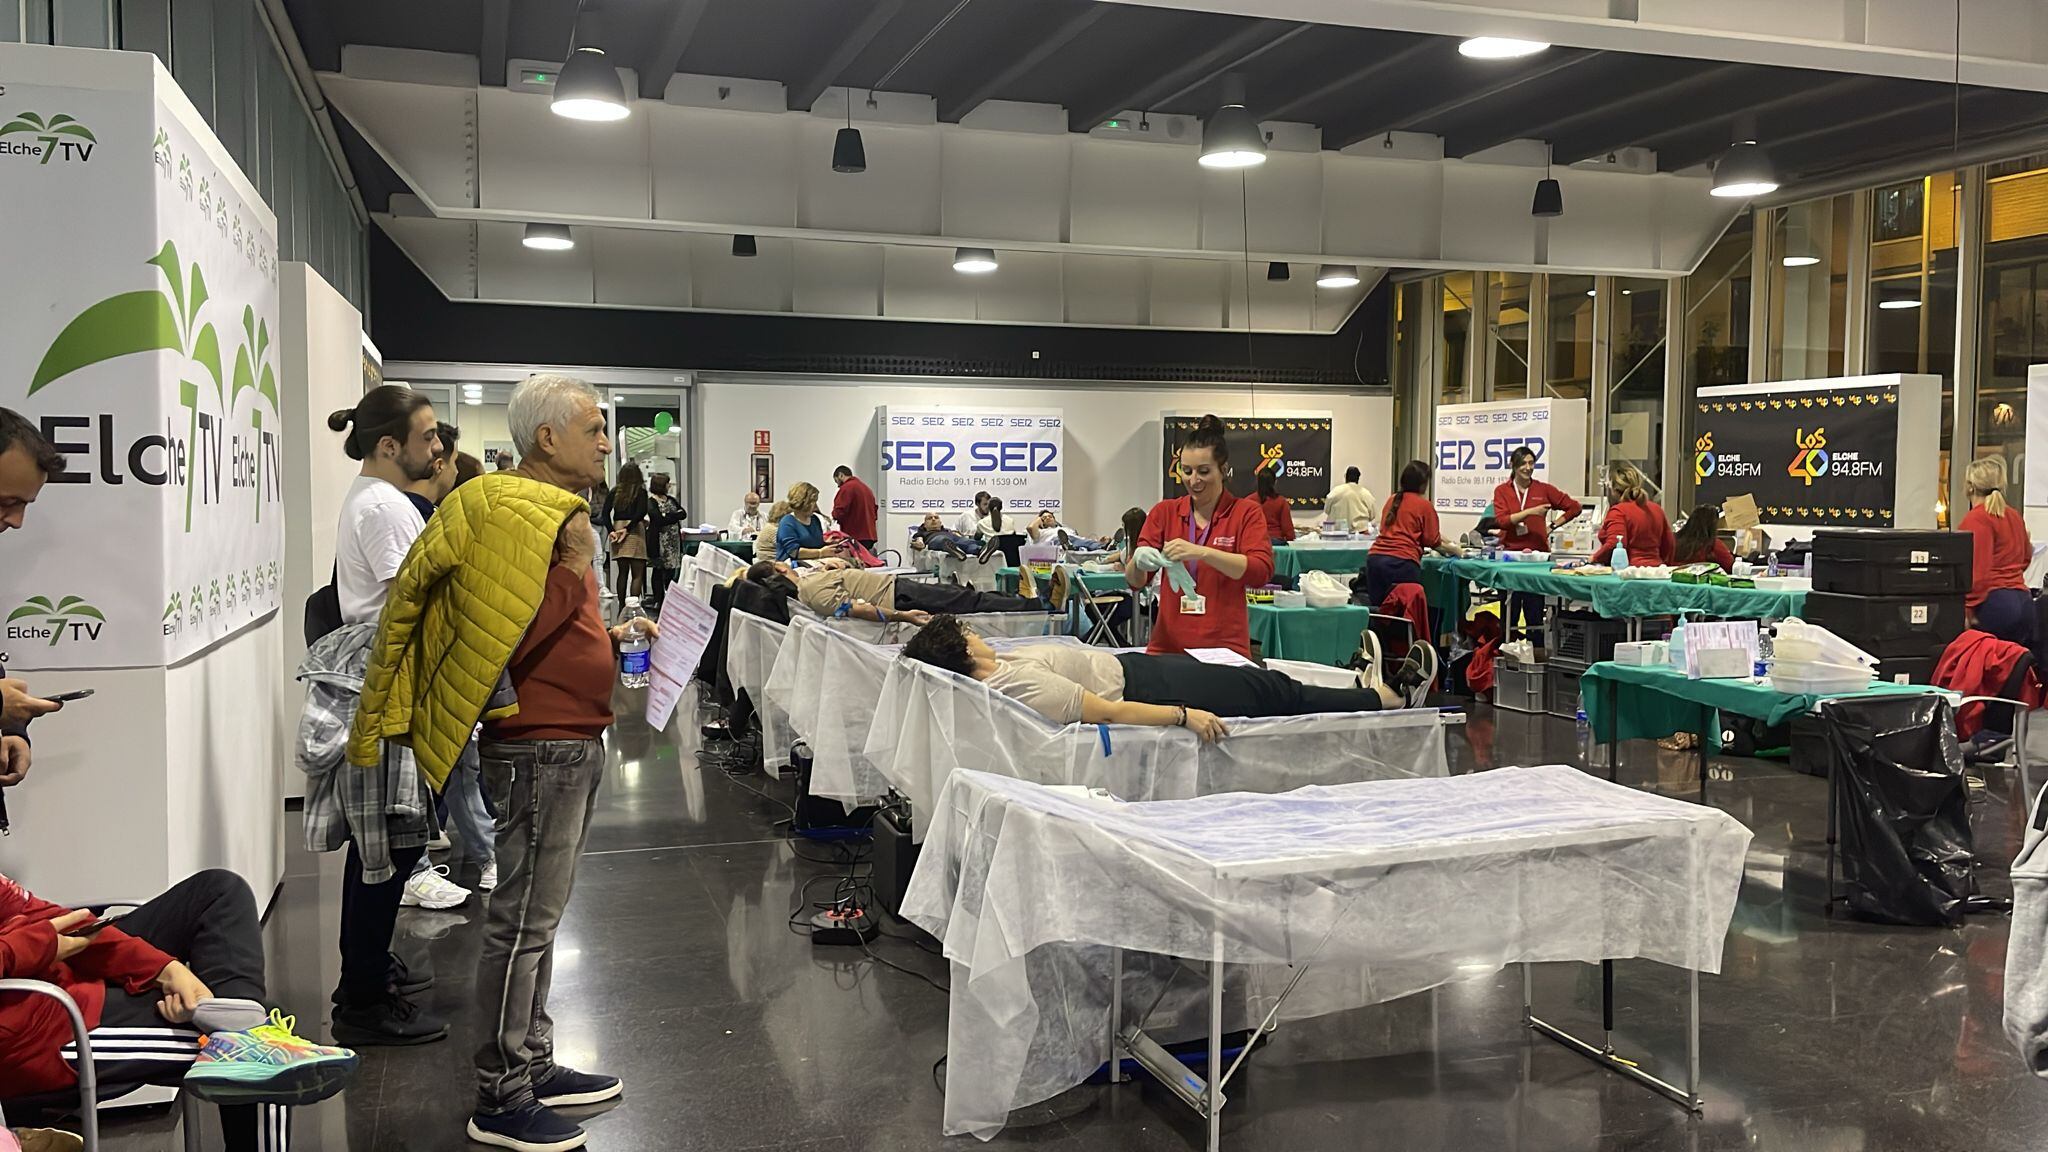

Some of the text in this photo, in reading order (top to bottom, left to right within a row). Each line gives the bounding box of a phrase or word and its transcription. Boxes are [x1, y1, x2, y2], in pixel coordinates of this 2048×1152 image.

[892, 417, 914, 425] SER
[922, 418, 944, 426] SER
[952, 418, 974, 426] SER
[981, 418, 1003, 426] SER
[1011, 419, 1032, 427] SER
[1039, 419, 1060, 427] SER
[881, 441, 1057, 471] SER SER
[1718, 454, 1740, 462] ELCHE
[1833, 452, 1858, 461] ELCHE
[1286, 467, 1322, 477] 94.8FM
[1718, 463, 1761, 477] 94.8FM
[1787, 449, 1829, 486] 40
[1831, 462, 1882, 476] 94.8FM
[892, 500, 914, 508] SER
[922, 500, 944, 508] SER
[952, 500, 973, 508] SER
[1010, 500, 1031, 508] SER
[1039, 500, 1060, 508] SER
[1914, 610, 1923, 618] 22
